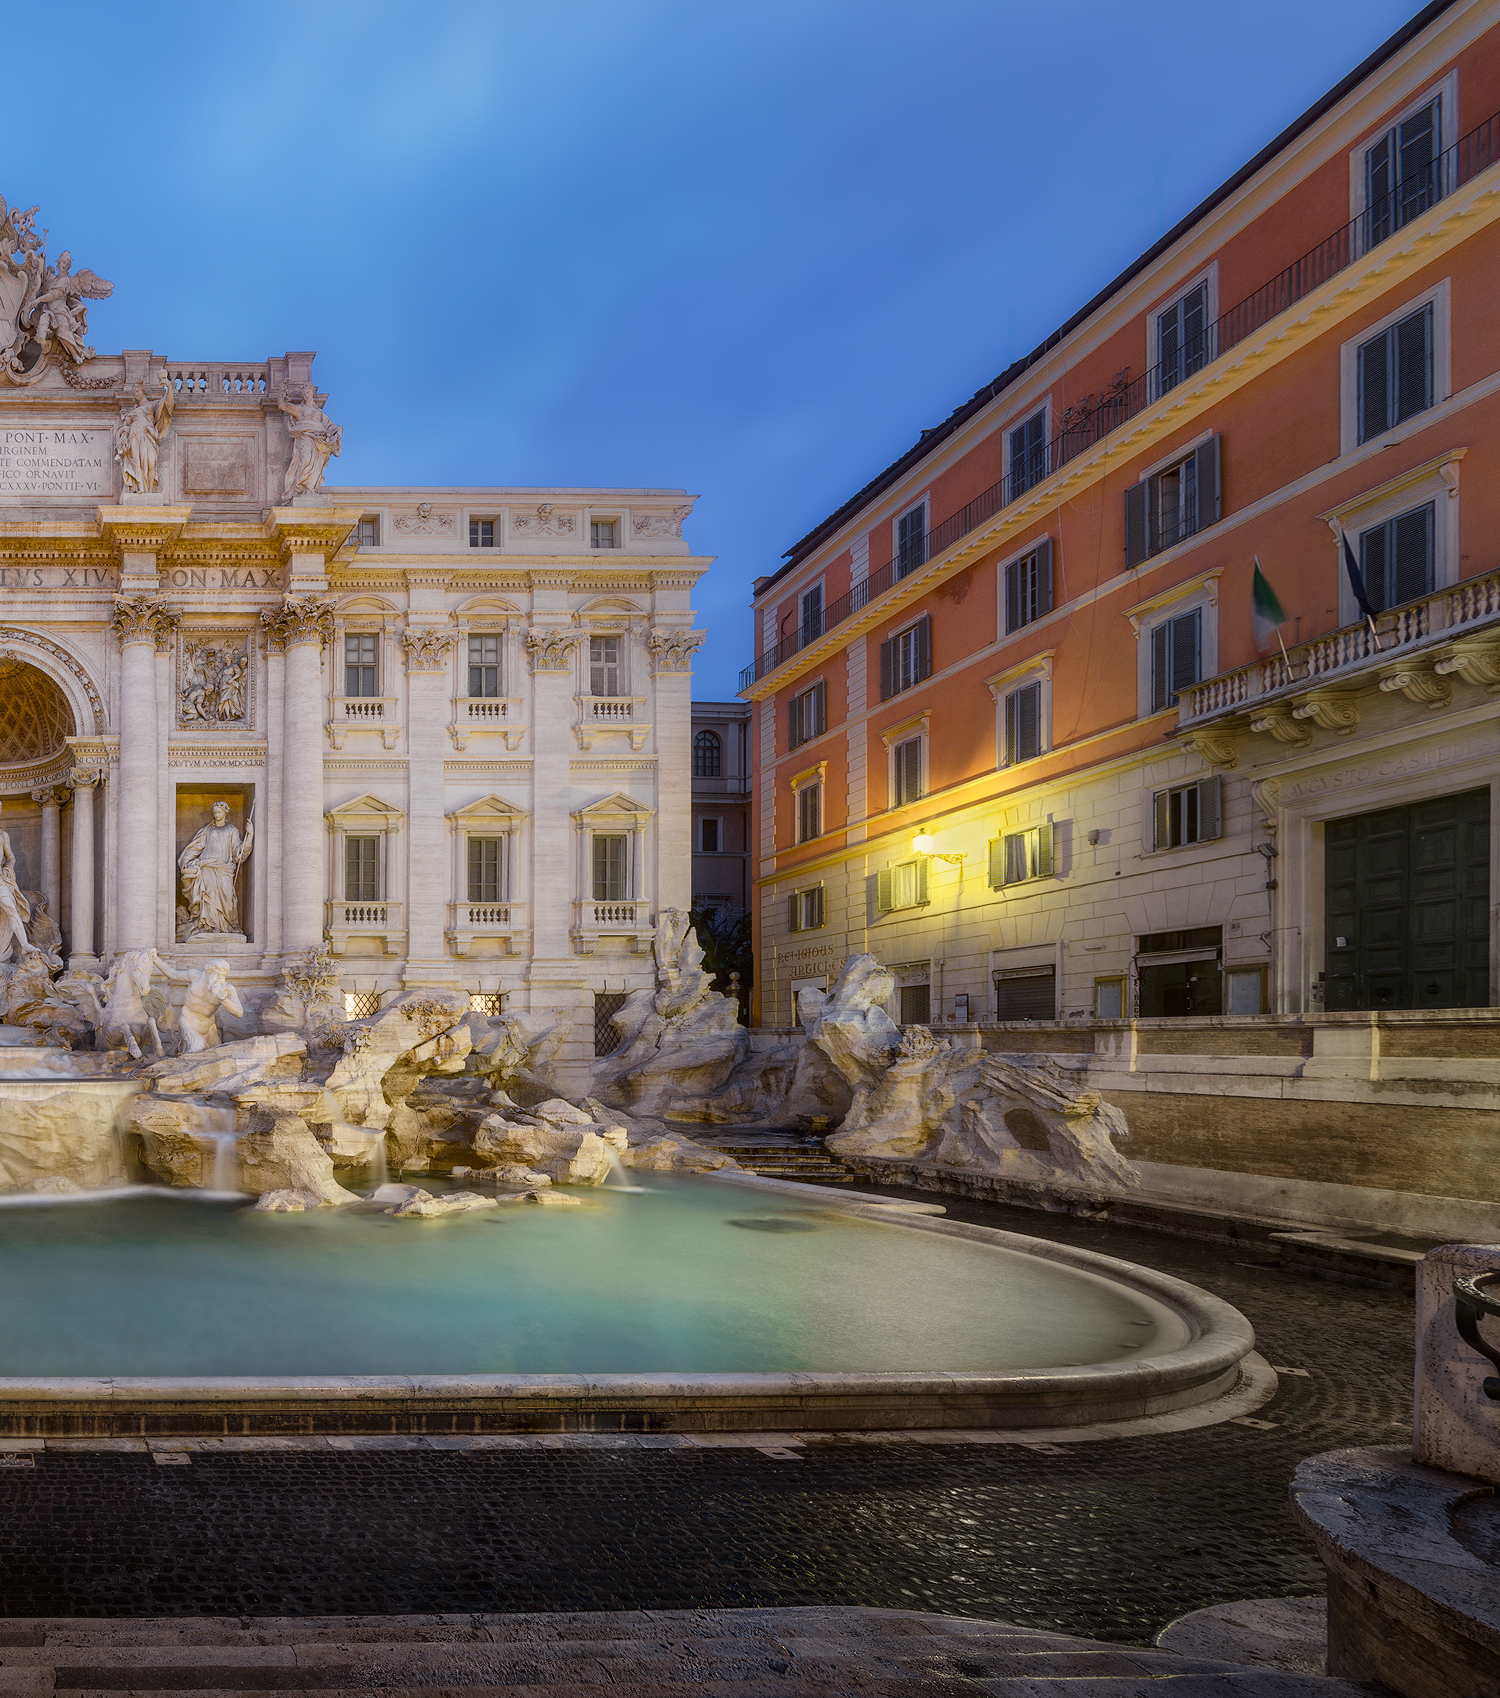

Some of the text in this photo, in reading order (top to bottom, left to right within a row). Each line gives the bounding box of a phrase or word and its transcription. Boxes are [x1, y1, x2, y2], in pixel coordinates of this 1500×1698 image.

[16, 458, 102, 467] COMMENDATAM
[26, 470, 75, 479] ORNAVIT
[777, 943, 834, 964] RELIGIOUS
[790, 958, 847, 977] ARTICLES
